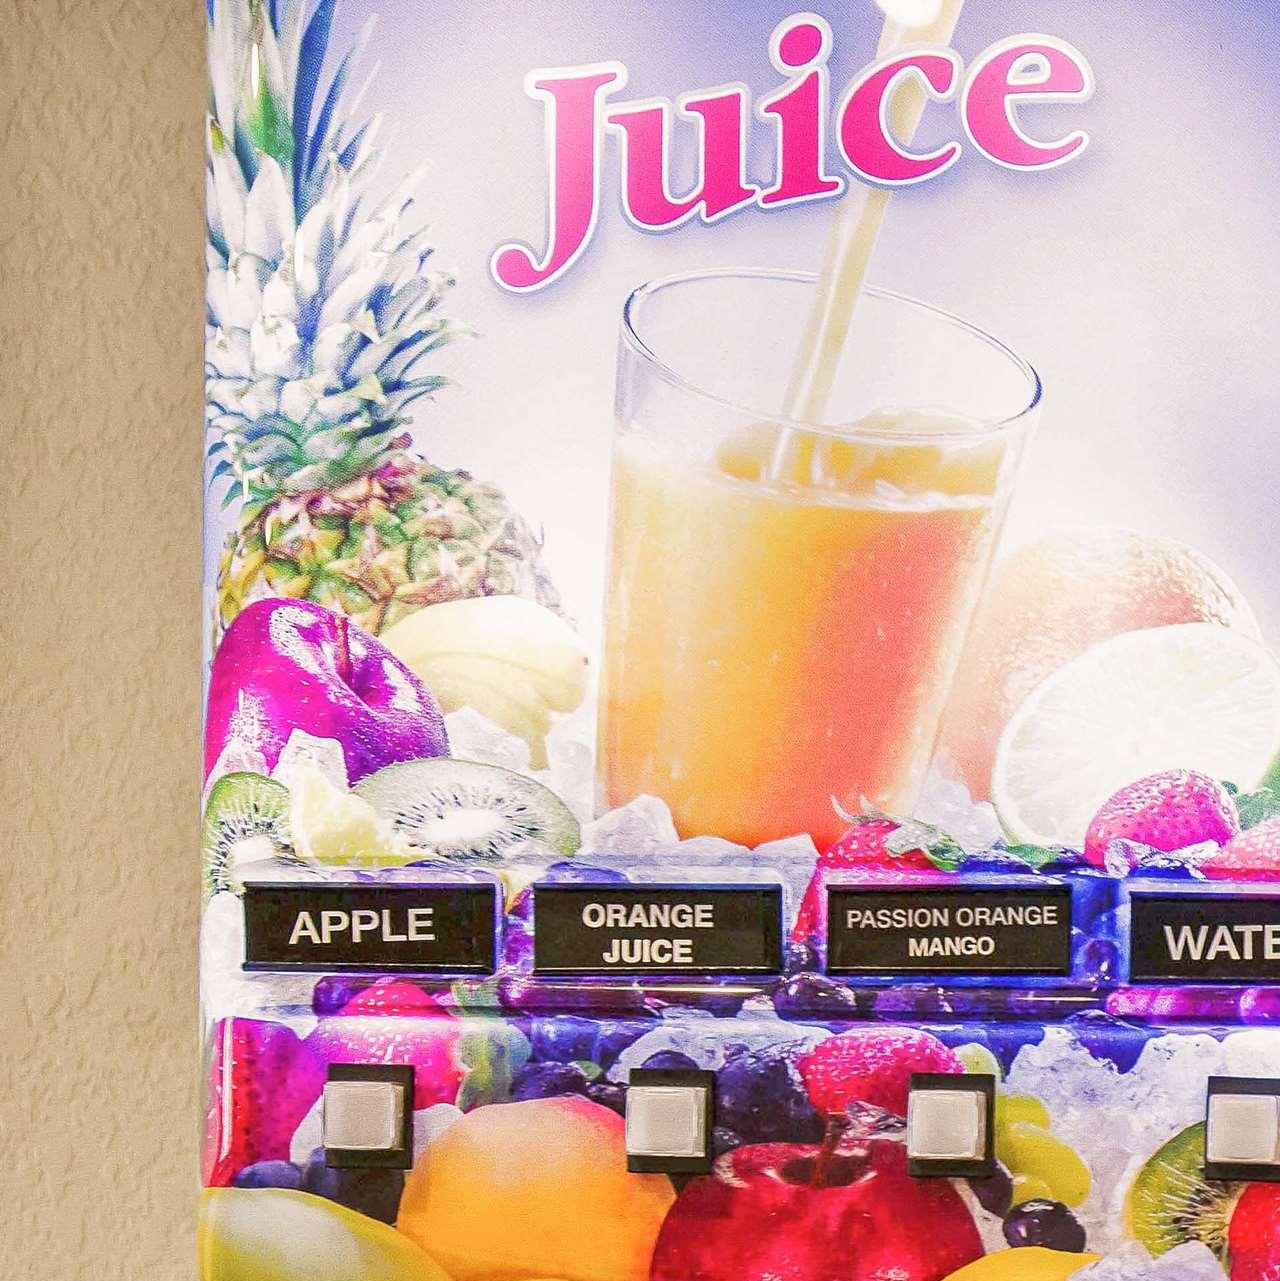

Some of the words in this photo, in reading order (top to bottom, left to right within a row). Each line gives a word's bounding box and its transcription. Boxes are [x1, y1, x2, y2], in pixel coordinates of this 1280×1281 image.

[491, 13, 1090, 292] Juice
[288, 907, 436, 945] APPLE
[582, 903, 715, 929] ORANGE
[846, 906, 950, 930] PASSION
[956, 904, 1059, 927] ORANGE
[602, 938, 693, 964] JUICE
[908, 935, 995, 958] MANGO
